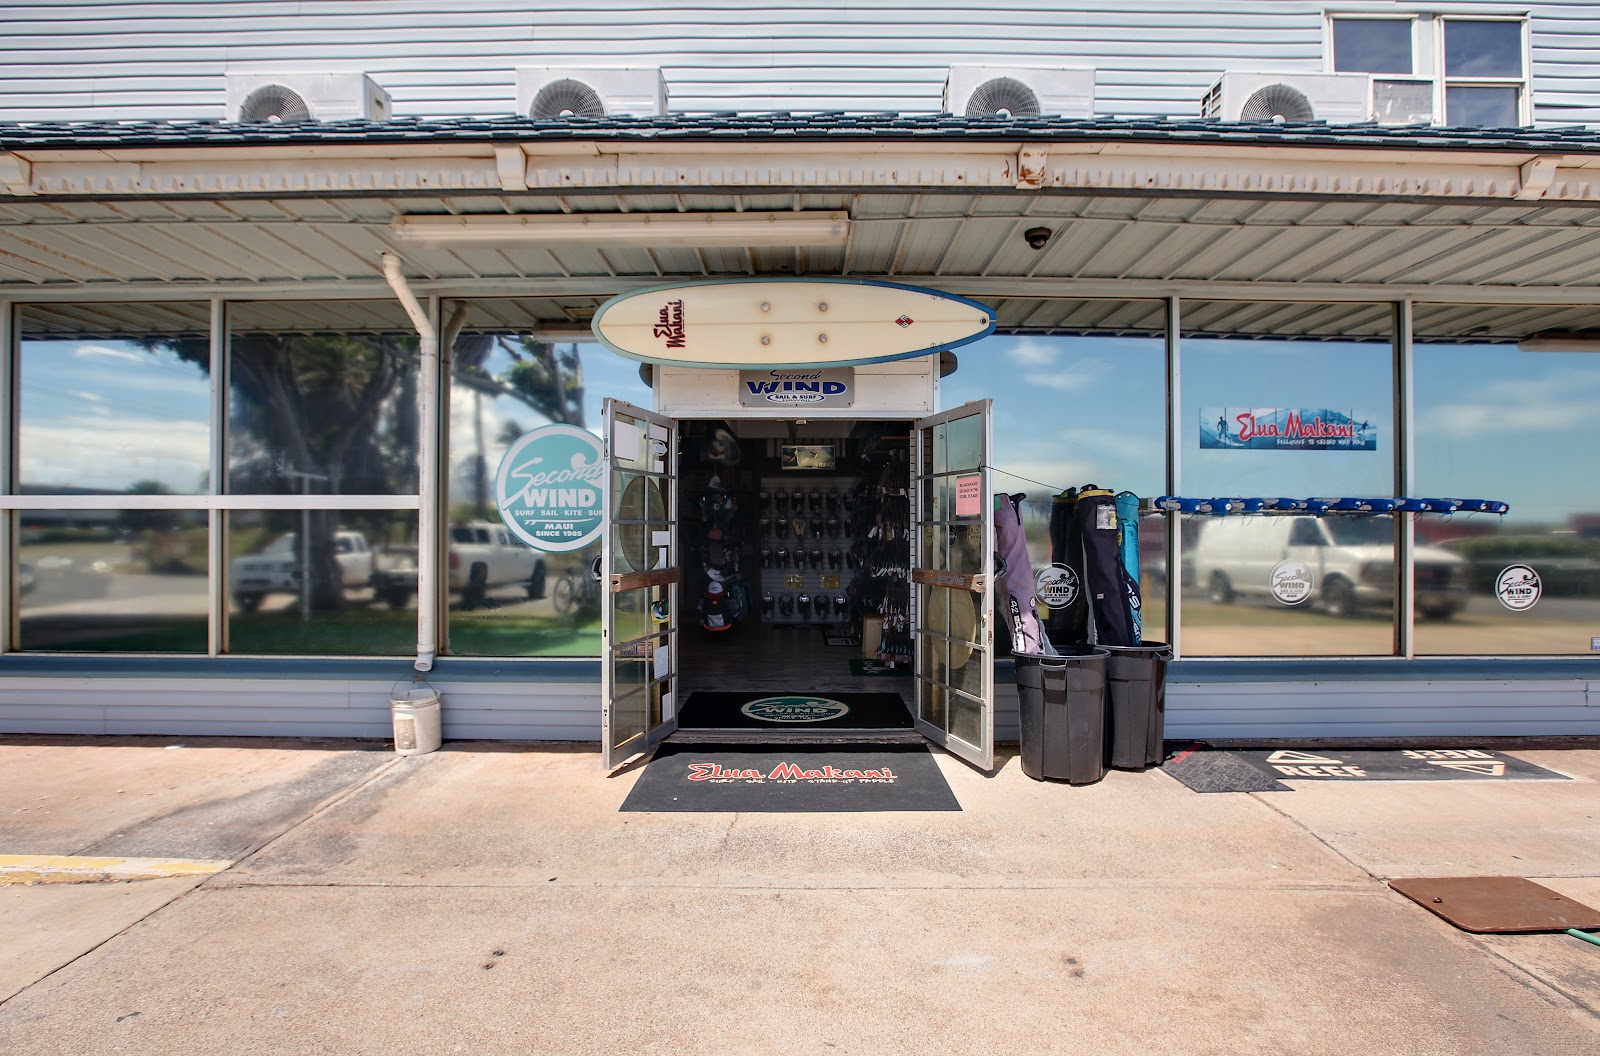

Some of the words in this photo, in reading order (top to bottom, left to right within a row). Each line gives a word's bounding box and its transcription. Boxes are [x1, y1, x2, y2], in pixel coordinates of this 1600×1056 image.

[653, 305, 672, 338] Elua
[666, 299, 685, 348] Makani
[769, 369, 822, 381] Second
[746, 381, 847, 395] WIND
[1236, 412, 1281, 442] Elua
[1283, 410, 1359, 438] Makani
[524, 488, 596, 508] WIND
[1044, 586, 1070, 594] WIND
[687, 762, 766, 781] Elua
[768, 761, 898, 780] Makani
[1271, 765, 1367, 777] REEF
